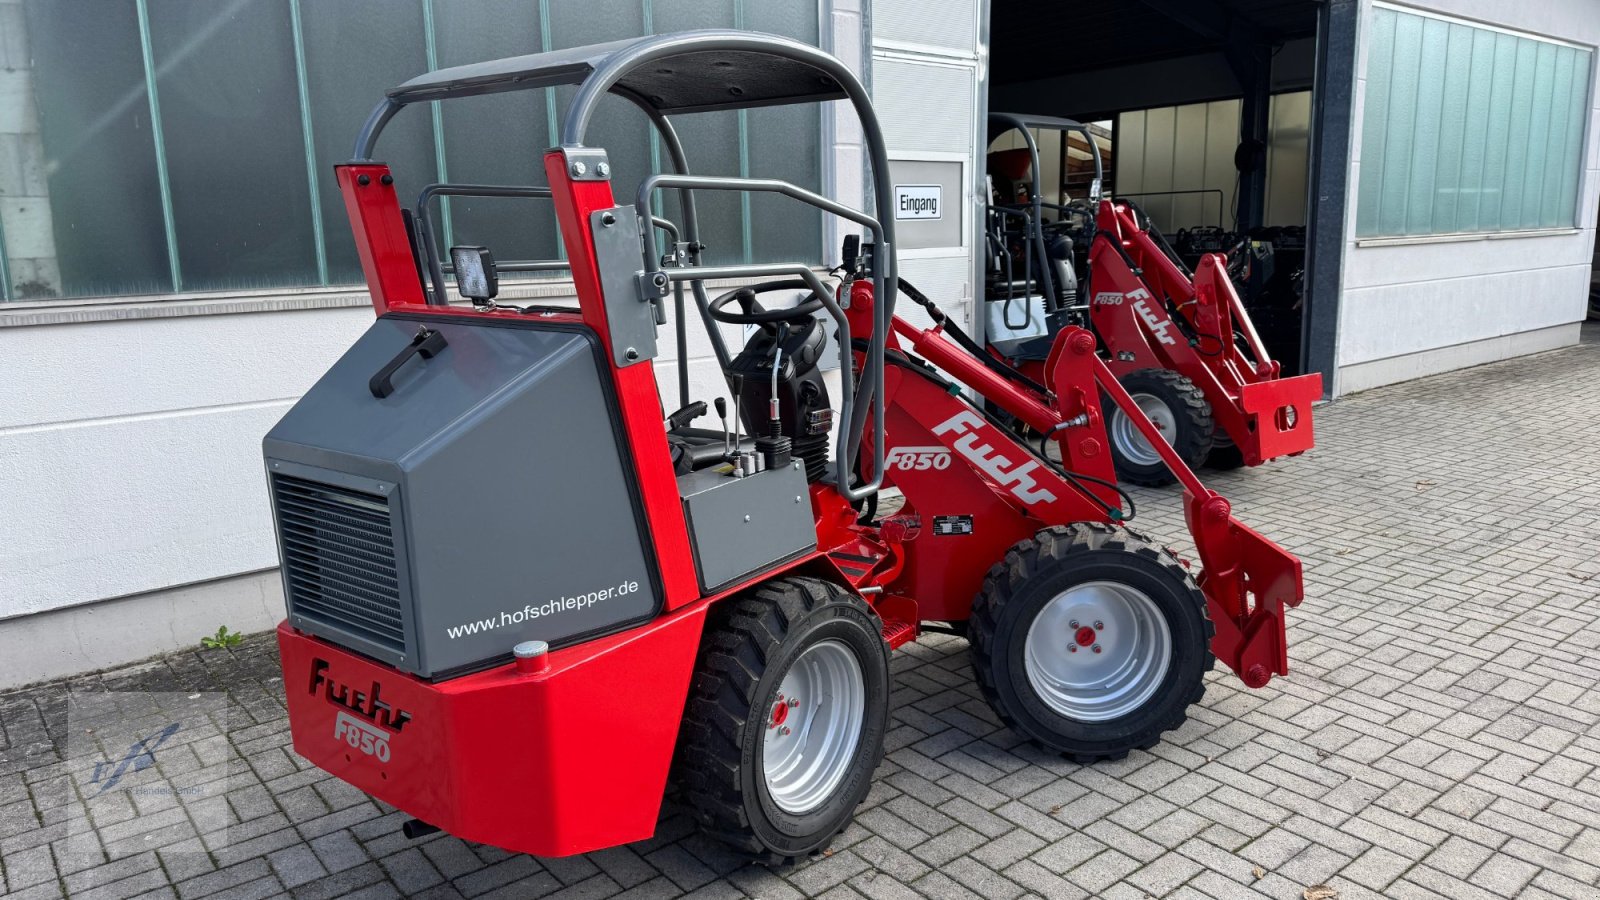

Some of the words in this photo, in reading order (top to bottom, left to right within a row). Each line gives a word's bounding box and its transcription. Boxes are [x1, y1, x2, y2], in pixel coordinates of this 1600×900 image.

[900, 194, 937, 214] Eingang
[1093, 292, 1124, 306] F850
[1125, 288, 1176, 345] Fuchs
[884, 446, 952, 471] F850
[931, 410, 1058, 505] Fuchs
[447, 581, 639, 640] www.hofschlepper.de
[309, 657, 412, 735] Fuchs
[334, 711, 391, 763] F850
